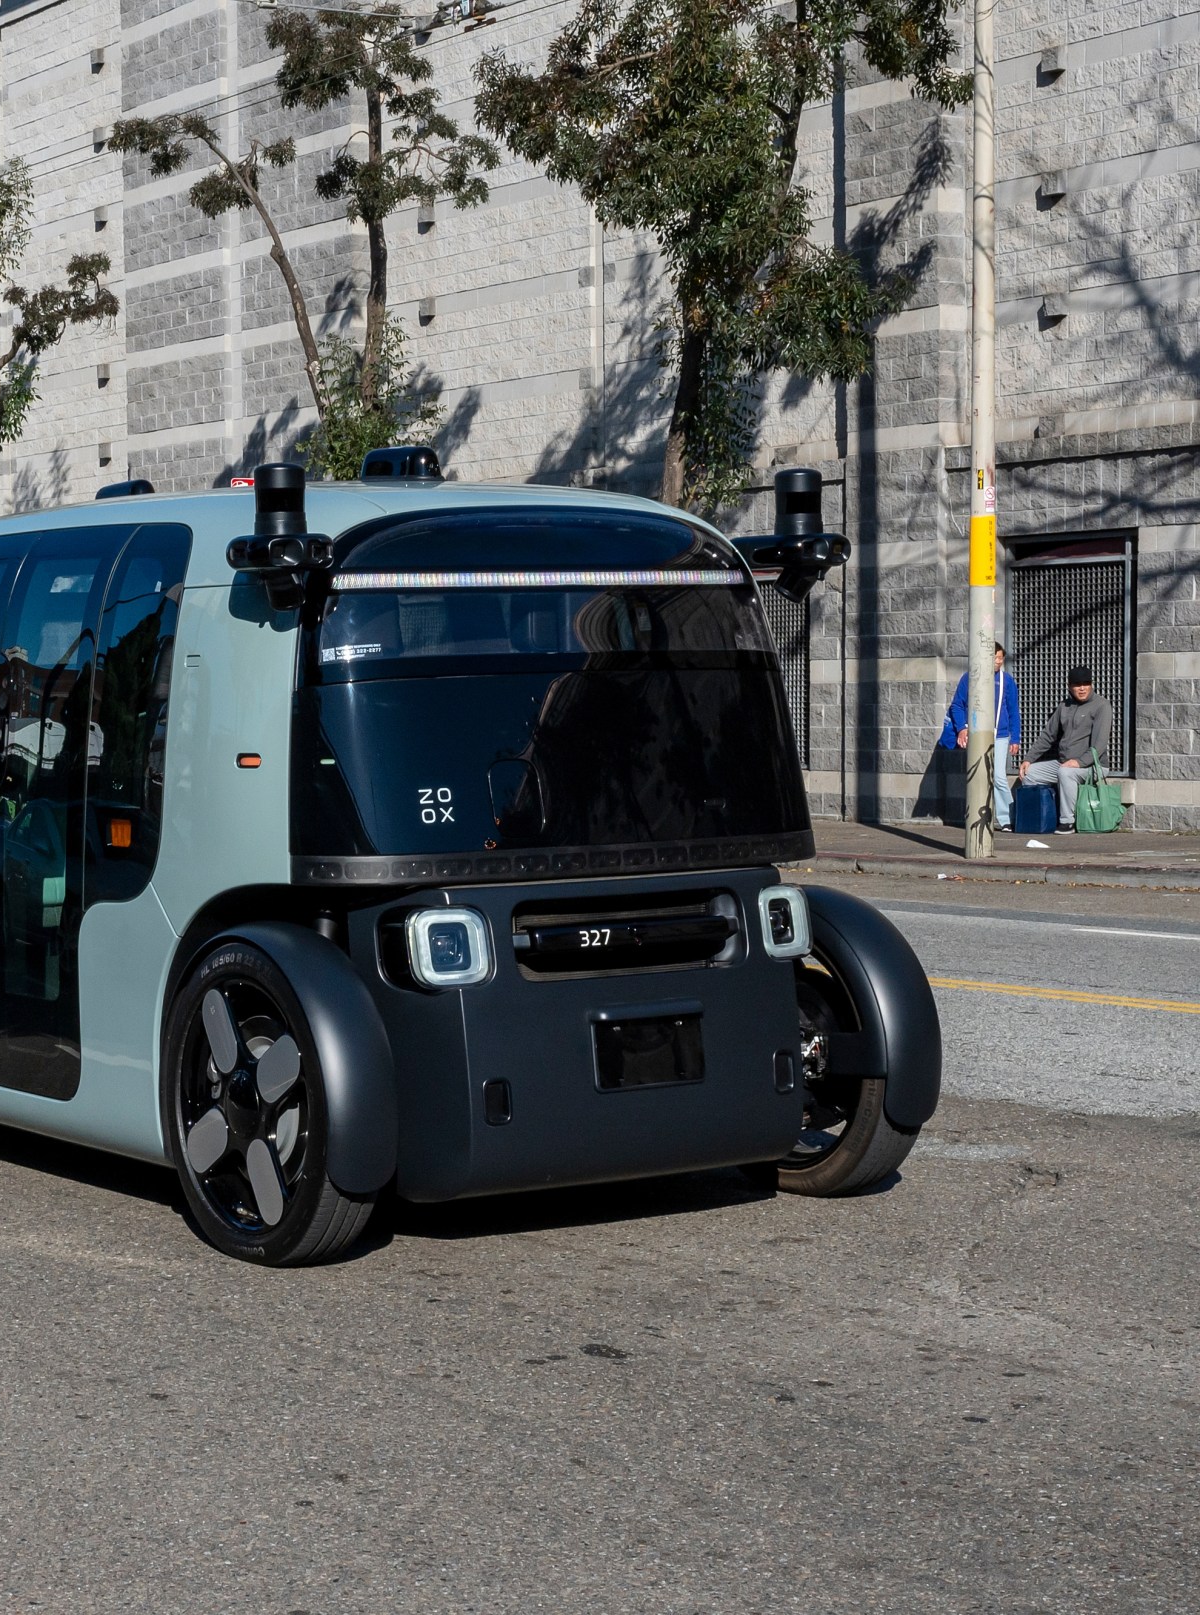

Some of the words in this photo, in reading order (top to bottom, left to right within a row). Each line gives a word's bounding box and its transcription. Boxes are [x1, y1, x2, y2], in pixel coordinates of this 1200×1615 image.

[417, 787, 452, 804] ZO
[421, 806, 456, 824] OX
[579, 929, 611, 947] 327
